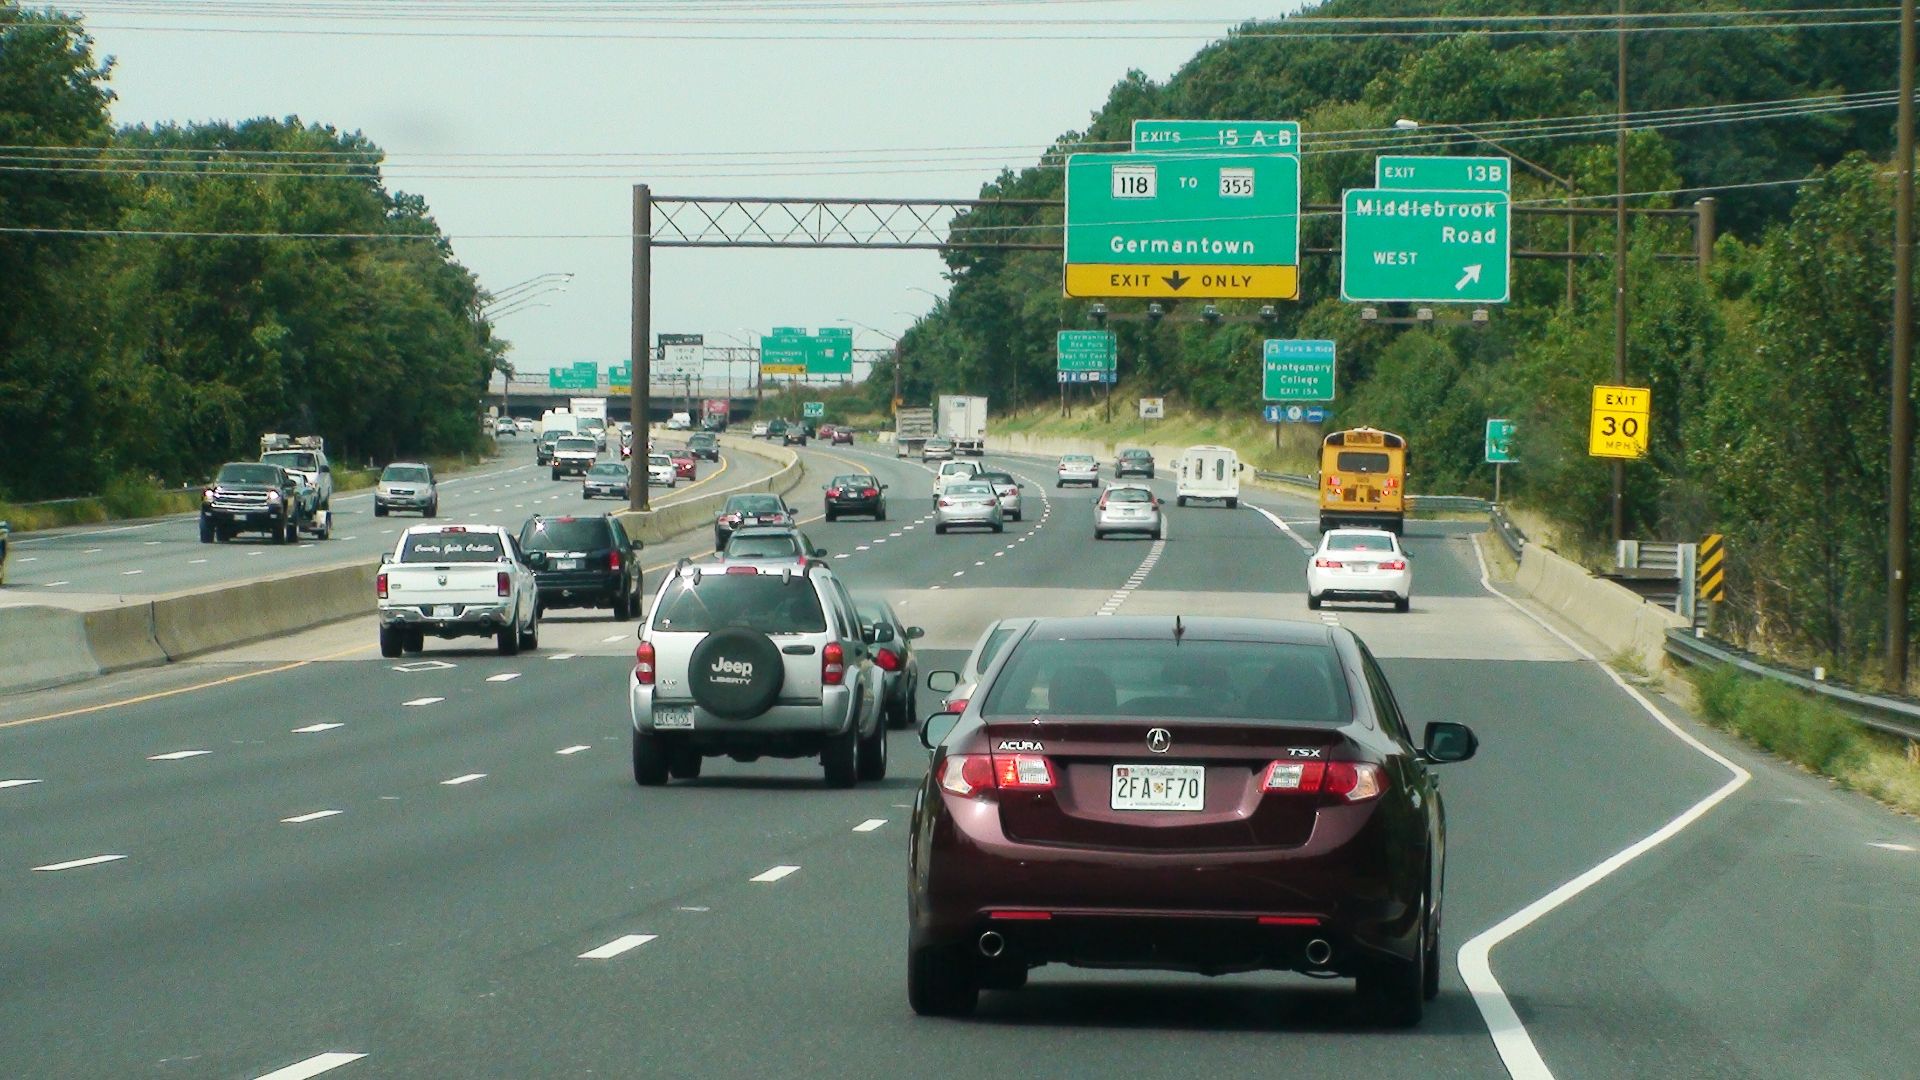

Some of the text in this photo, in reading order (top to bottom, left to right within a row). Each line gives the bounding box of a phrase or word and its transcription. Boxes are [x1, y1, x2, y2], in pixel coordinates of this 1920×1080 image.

[1140, 129, 1292, 146] EXITS 15 A-B
[1384, 165, 1502, 182] EXIT 13B
[1120, 176, 1252, 194] 118 TO 355
[1356, 198, 1496, 217] Middlebrook
[1441, 226, 1497, 244] Road
[1110, 236, 1255, 254] Germantown
[1373, 251, 1418, 265] WEST
[1110, 274, 1252, 287] EXIT ONLY
[1266, 362, 1331, 374] Montgomery
[1280, 375, 1319, 386] College
[1606, 394, 1638, 406] EXIT
[1601, 416, 1638, 437] 30
[1605, 441, 1631, 450] MPH
[711, 656, 753, 677] Jeep
[709, 676, 752, 685] LIBERTY
[998, 740, 1045, 751] ACURA
[1287, 748, 1321, 758] TSX
